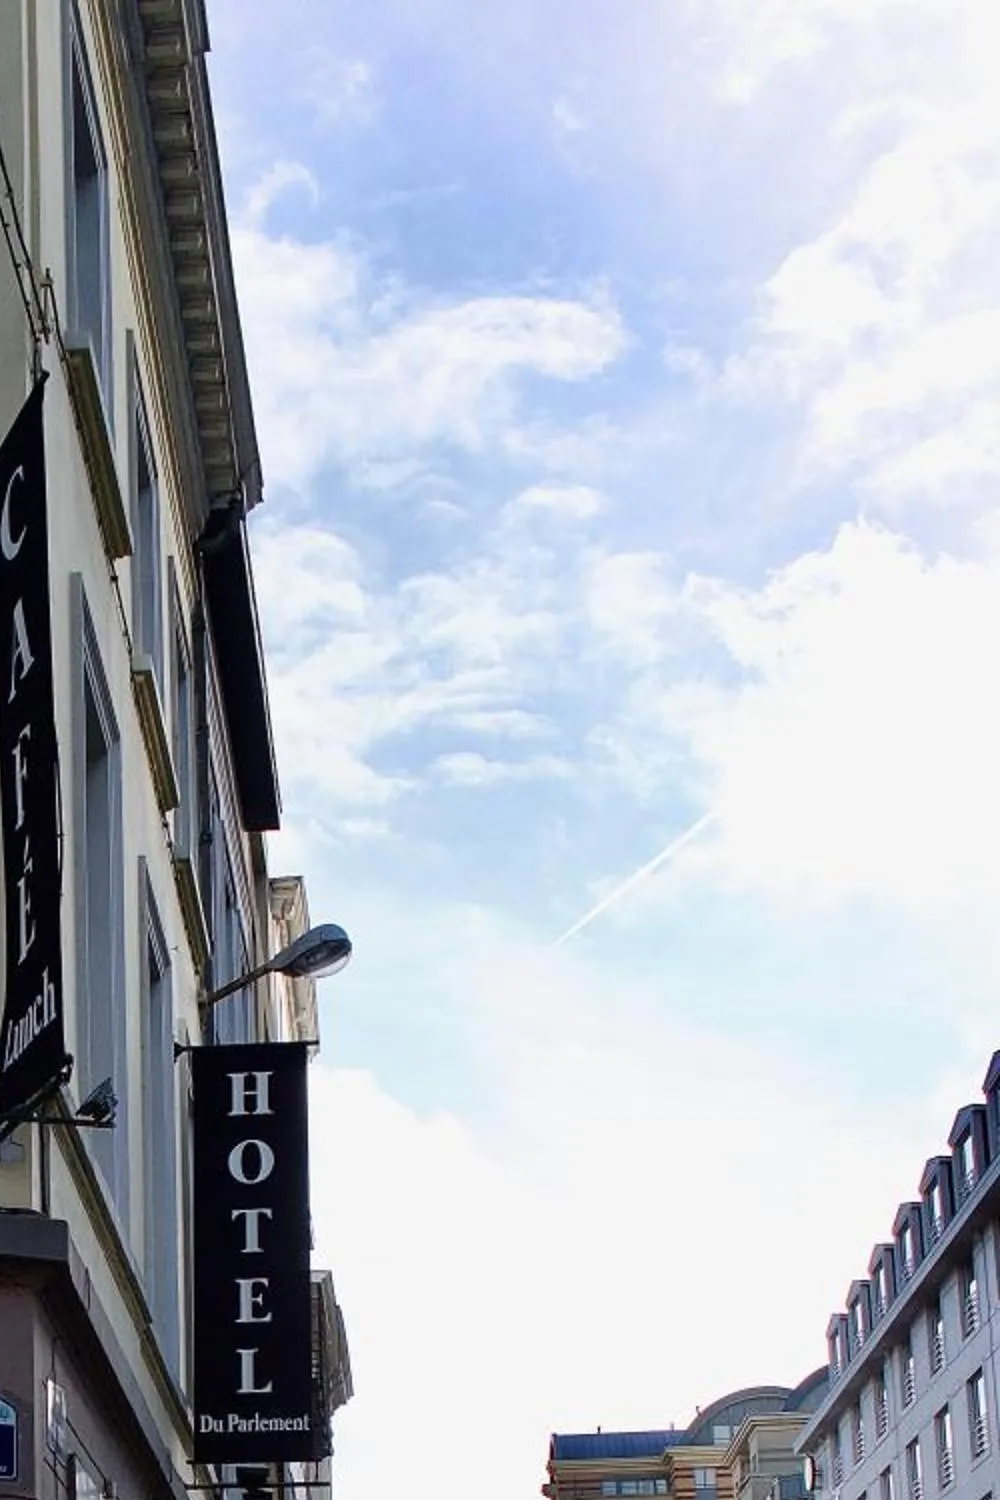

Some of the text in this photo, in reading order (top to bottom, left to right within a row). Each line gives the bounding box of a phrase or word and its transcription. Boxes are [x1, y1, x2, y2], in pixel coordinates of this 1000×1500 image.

[3, 965, 57, 1073] Lunch
[226, 1071, 275, 1395] HOTEL
[200, 1413, 310, 1433] Du Parlement
